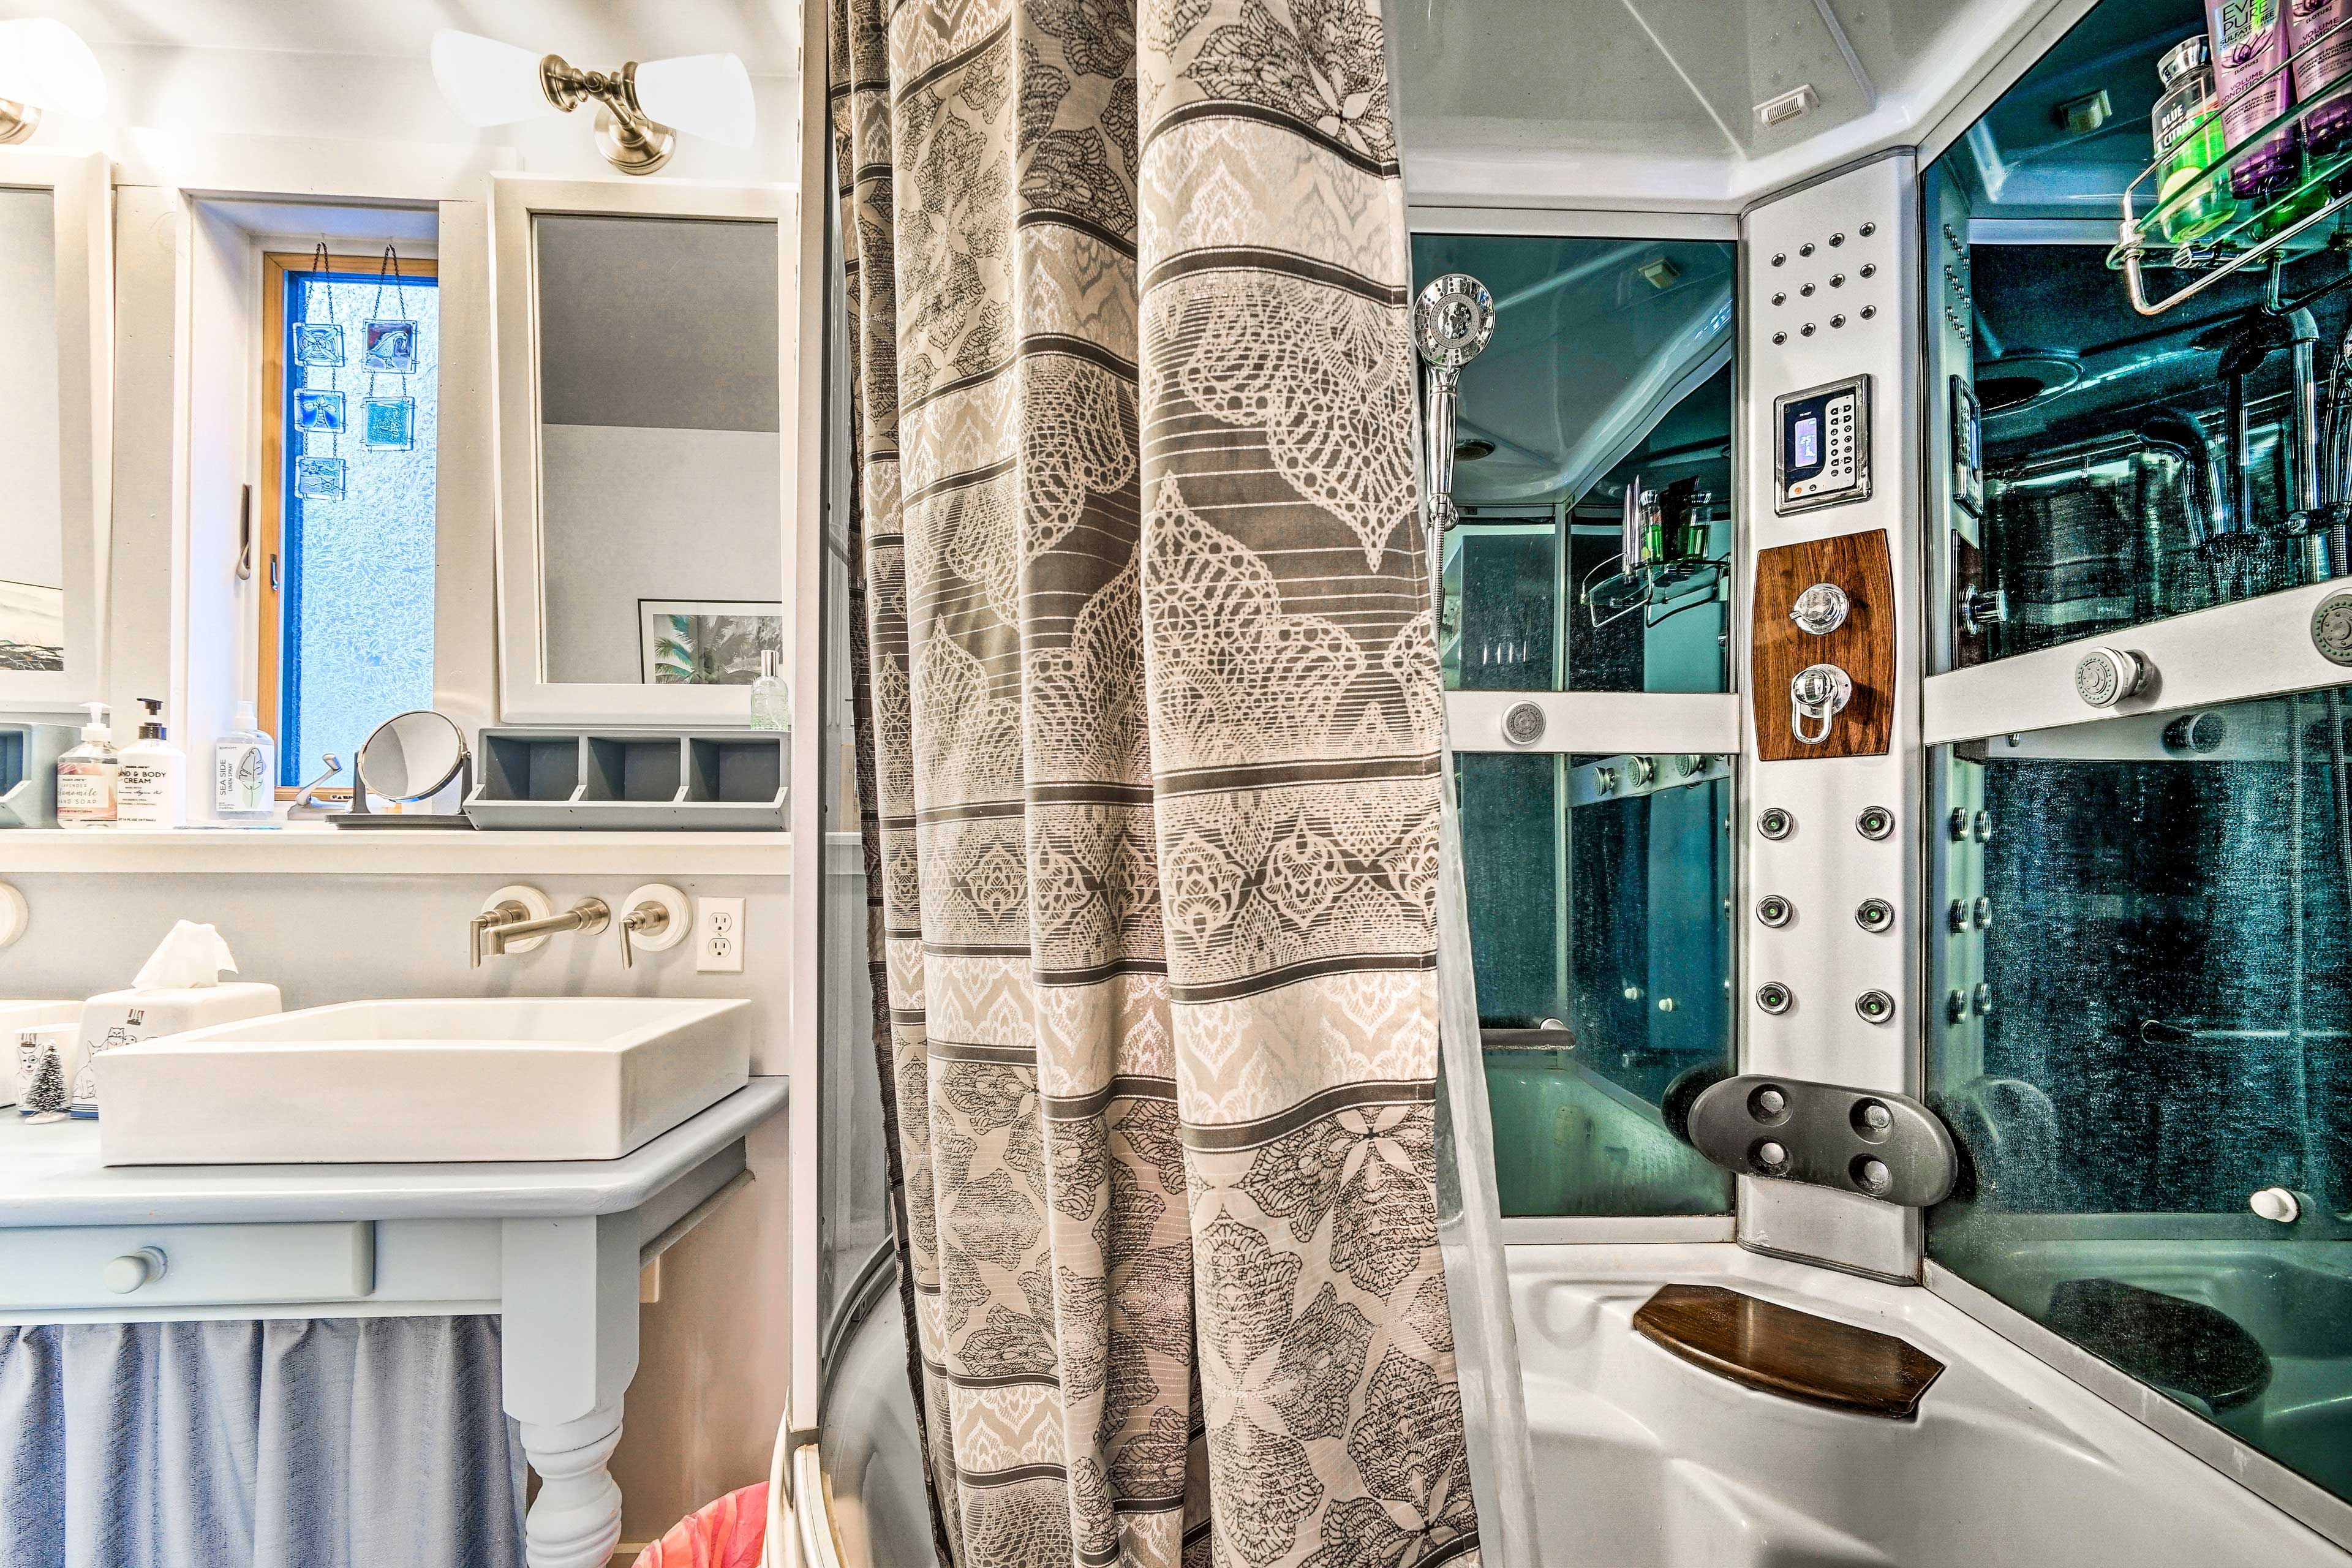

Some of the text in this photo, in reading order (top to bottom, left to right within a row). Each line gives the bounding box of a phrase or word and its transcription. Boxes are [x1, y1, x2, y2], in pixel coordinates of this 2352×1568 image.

[2223, 0, 2269, 36] PURE
[2303, 17, 2339, 40] VOLUME
[2298, 21, 2343, 50] SHAMPO
[2318, 47, 2351, 64] BOTANICALS
[2231, 69, 2264, 90] VOLUME
[2244, 98, 2274, 113] BOTANICALS
[2252, 89, 2276, 102] FULLNESS
[2162, 104, 2184, 130] BLUE
